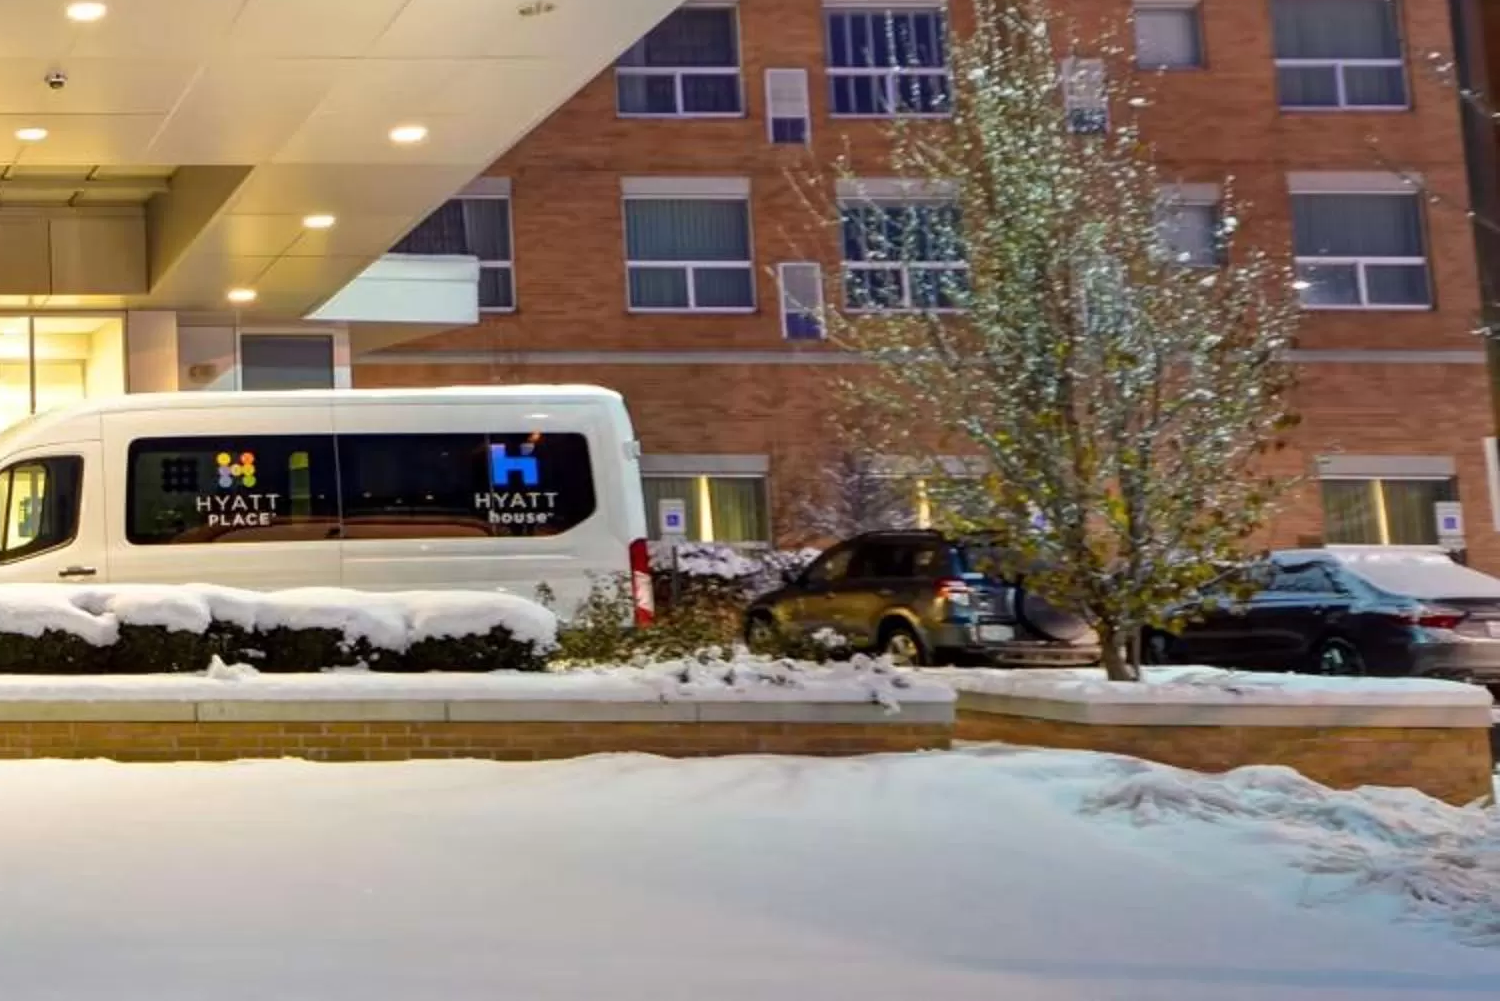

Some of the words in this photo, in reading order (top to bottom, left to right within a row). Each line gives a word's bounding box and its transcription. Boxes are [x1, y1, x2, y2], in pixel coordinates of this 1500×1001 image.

[196, 493, 280, 511] HYATT
[474, 492, 558, 509] HYATT
[208, 512, 271, 527] PLACE
[488, 510, 548, 524] house
